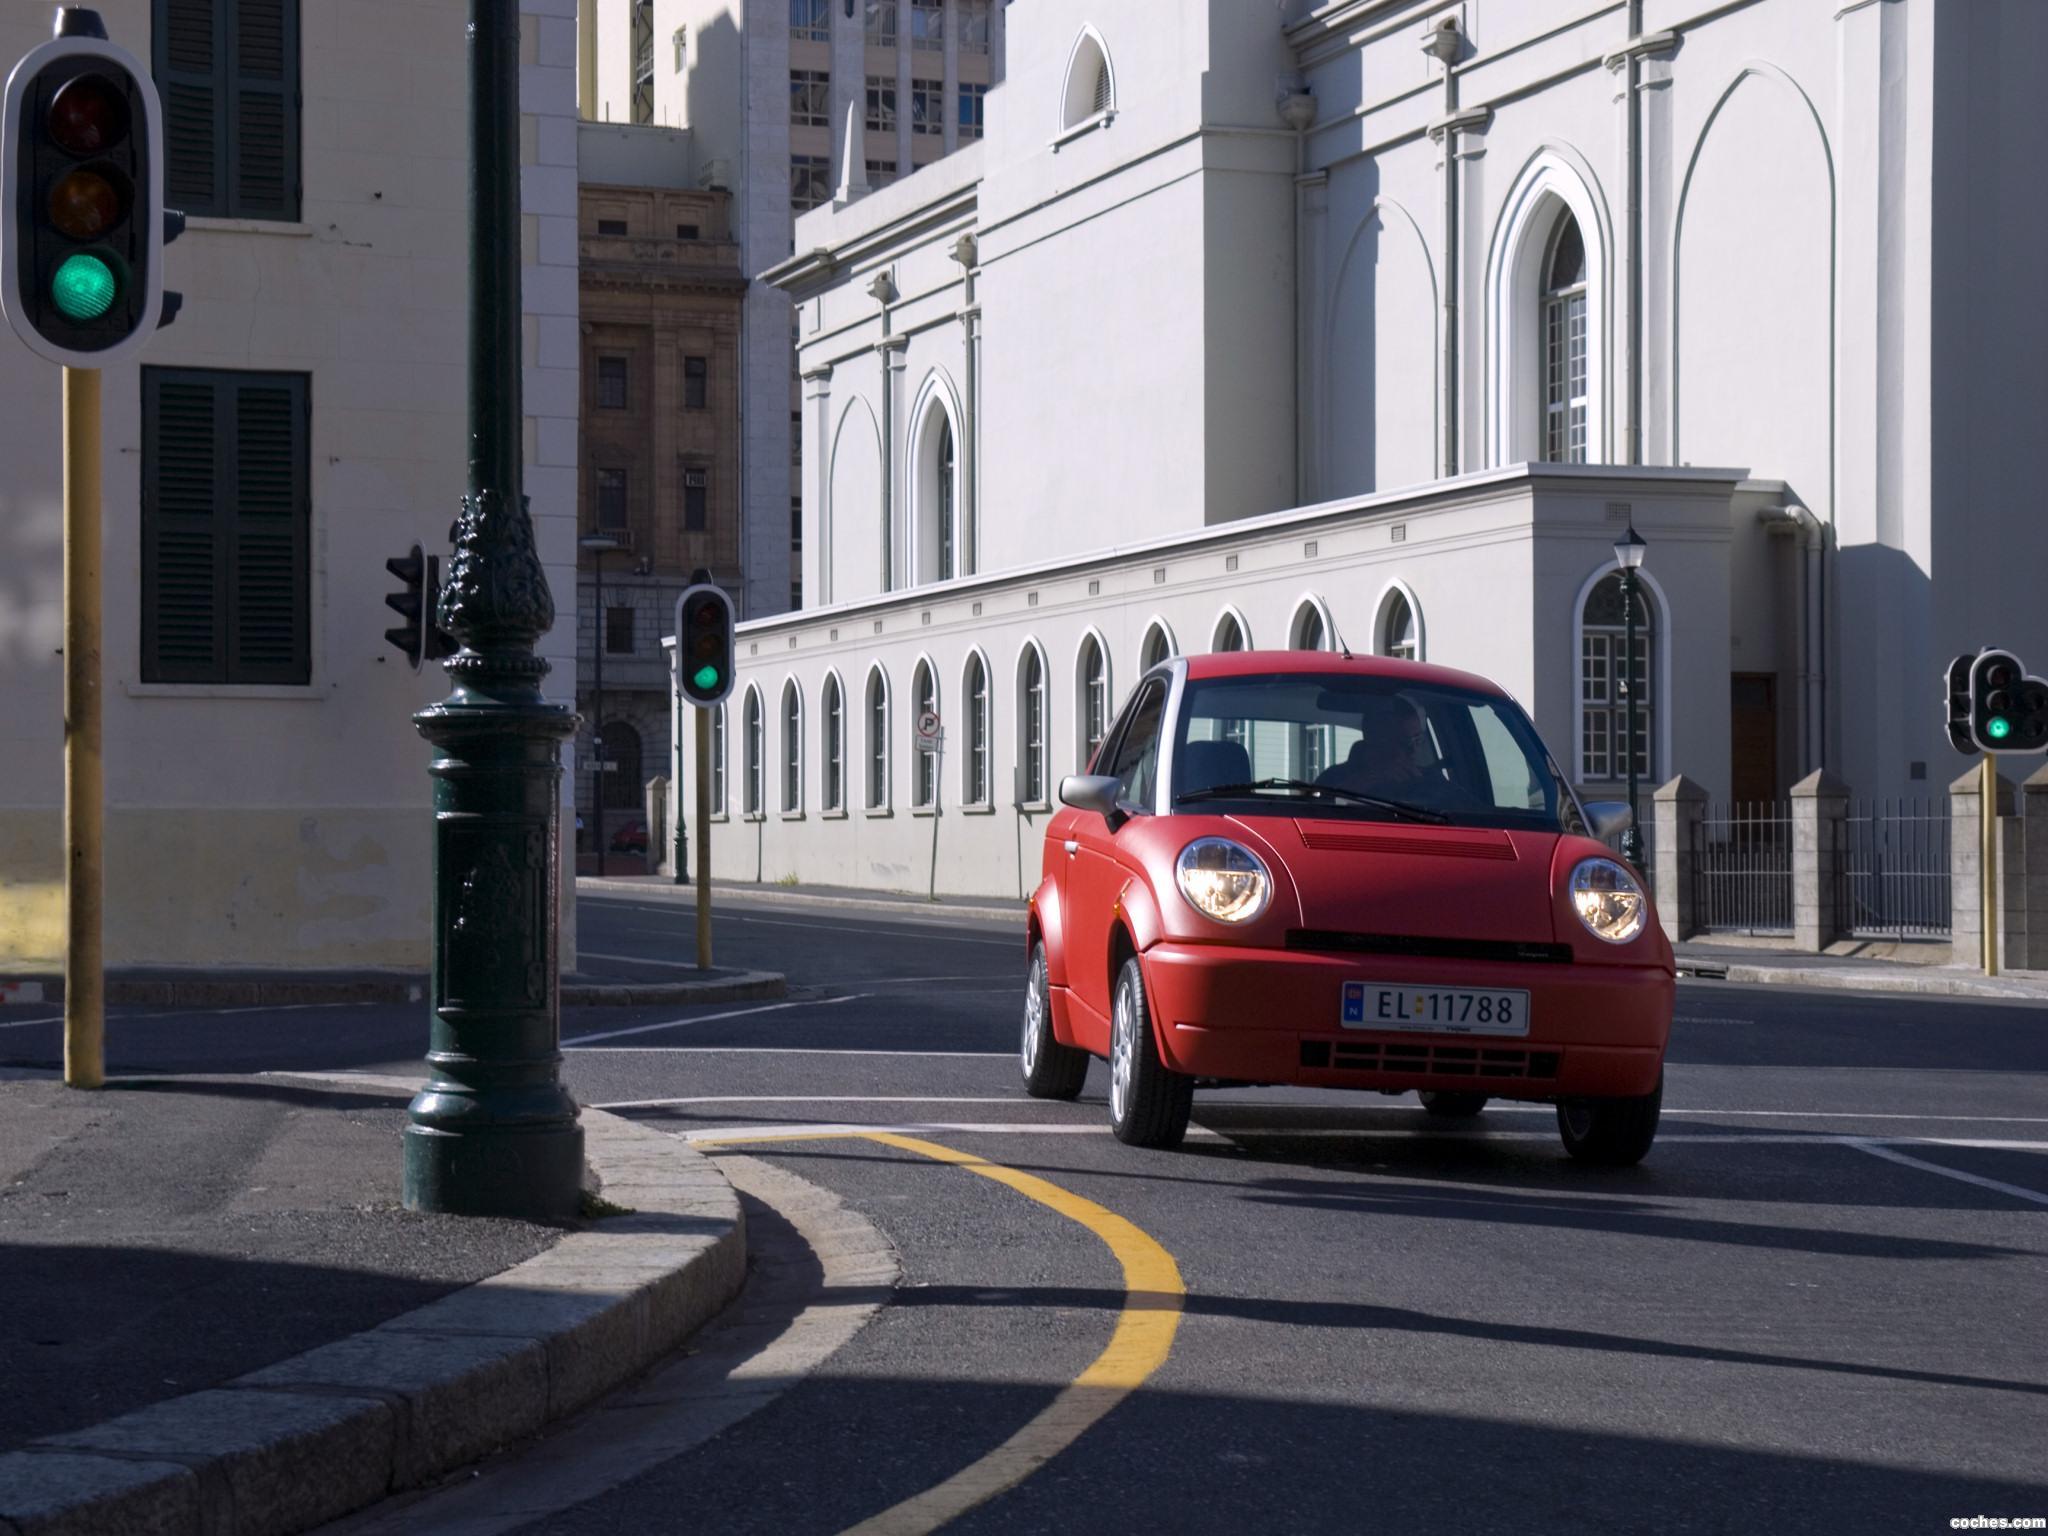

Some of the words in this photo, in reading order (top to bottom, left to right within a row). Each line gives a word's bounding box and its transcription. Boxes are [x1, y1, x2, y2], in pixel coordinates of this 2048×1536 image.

[924, 717, 934, 730] P
[1349, 1007, 1358, 1016] N
[1378, 991, 1410, 1020] EL
[1428, 993, 1513, 1024] 11788
